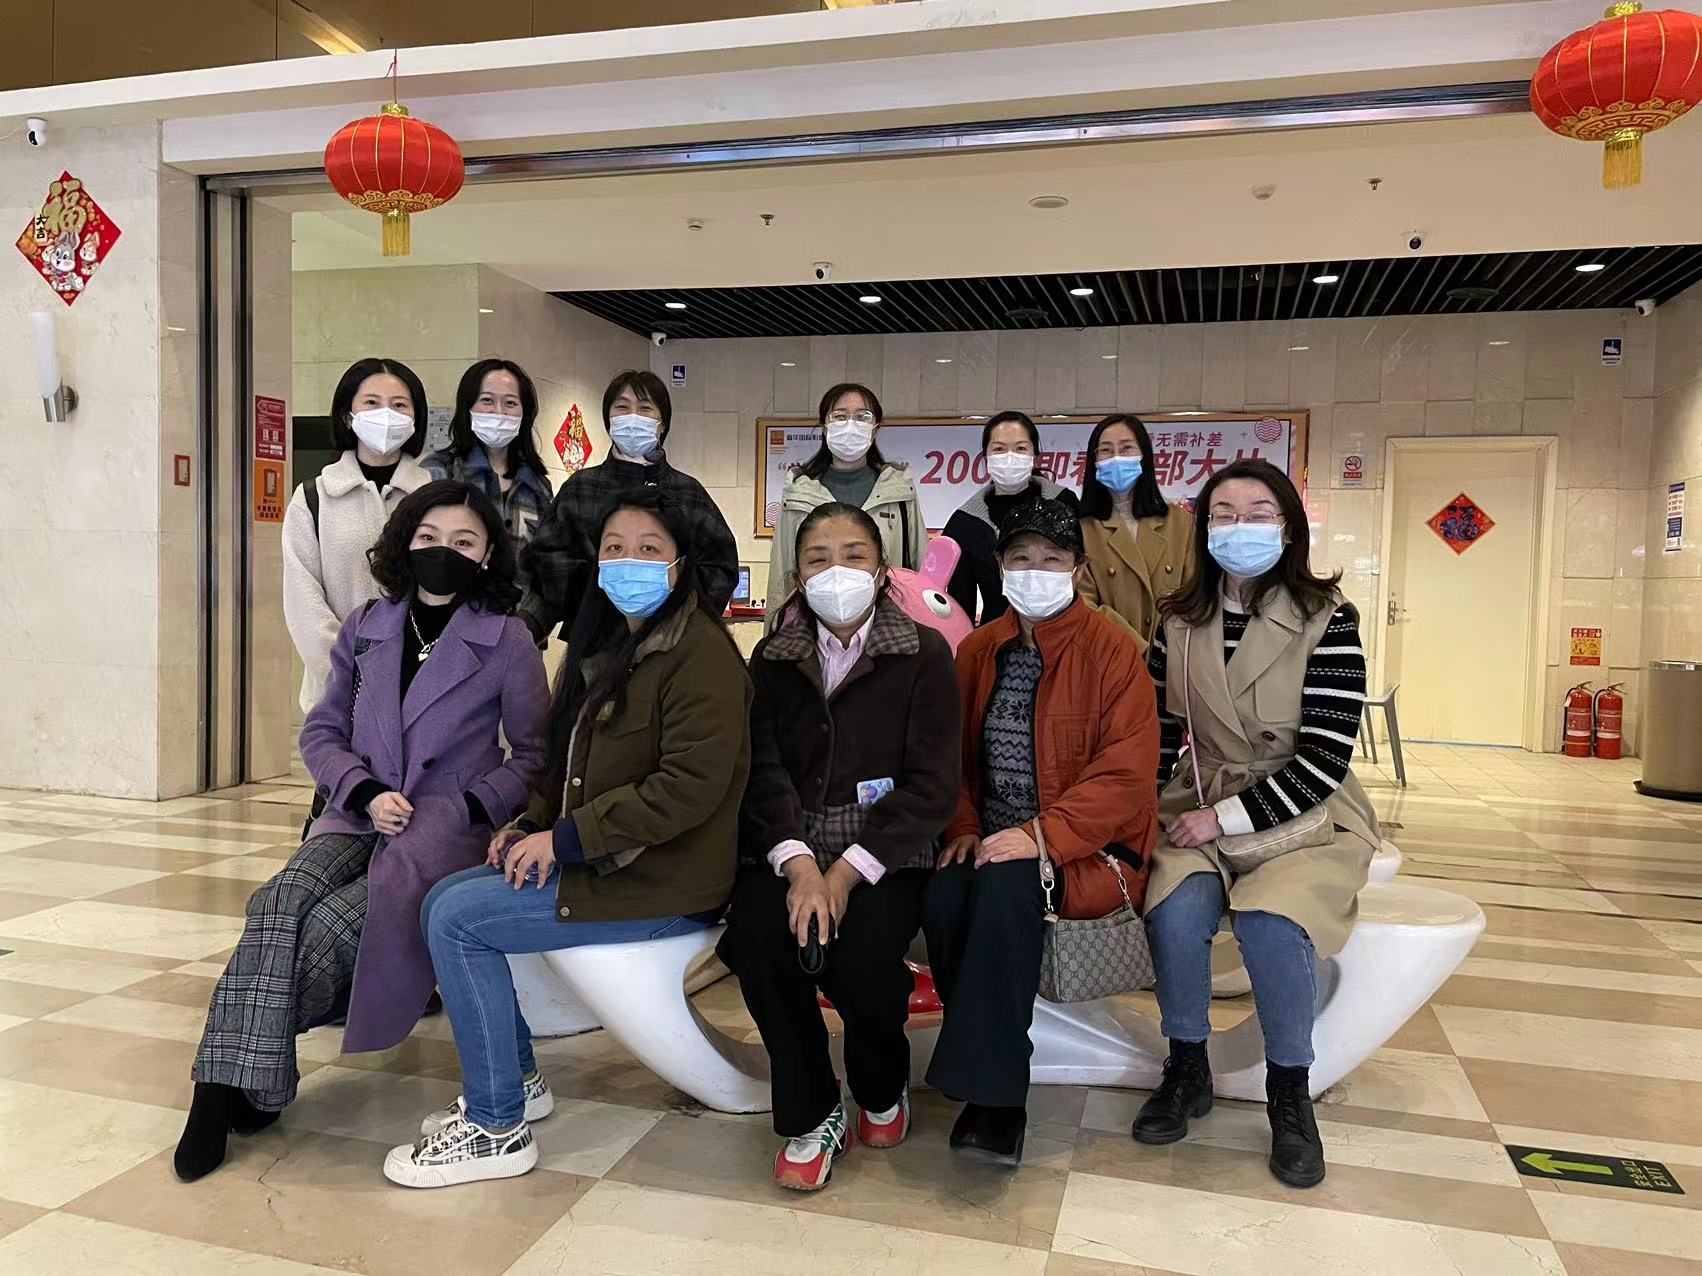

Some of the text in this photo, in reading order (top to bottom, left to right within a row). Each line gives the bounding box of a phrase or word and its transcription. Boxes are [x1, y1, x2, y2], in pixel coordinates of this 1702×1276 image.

[42, 178, 88, 235] 福
[35, 214, 48, 239] 大吉
[1643, 1165, 1672, 1187] EXIT
